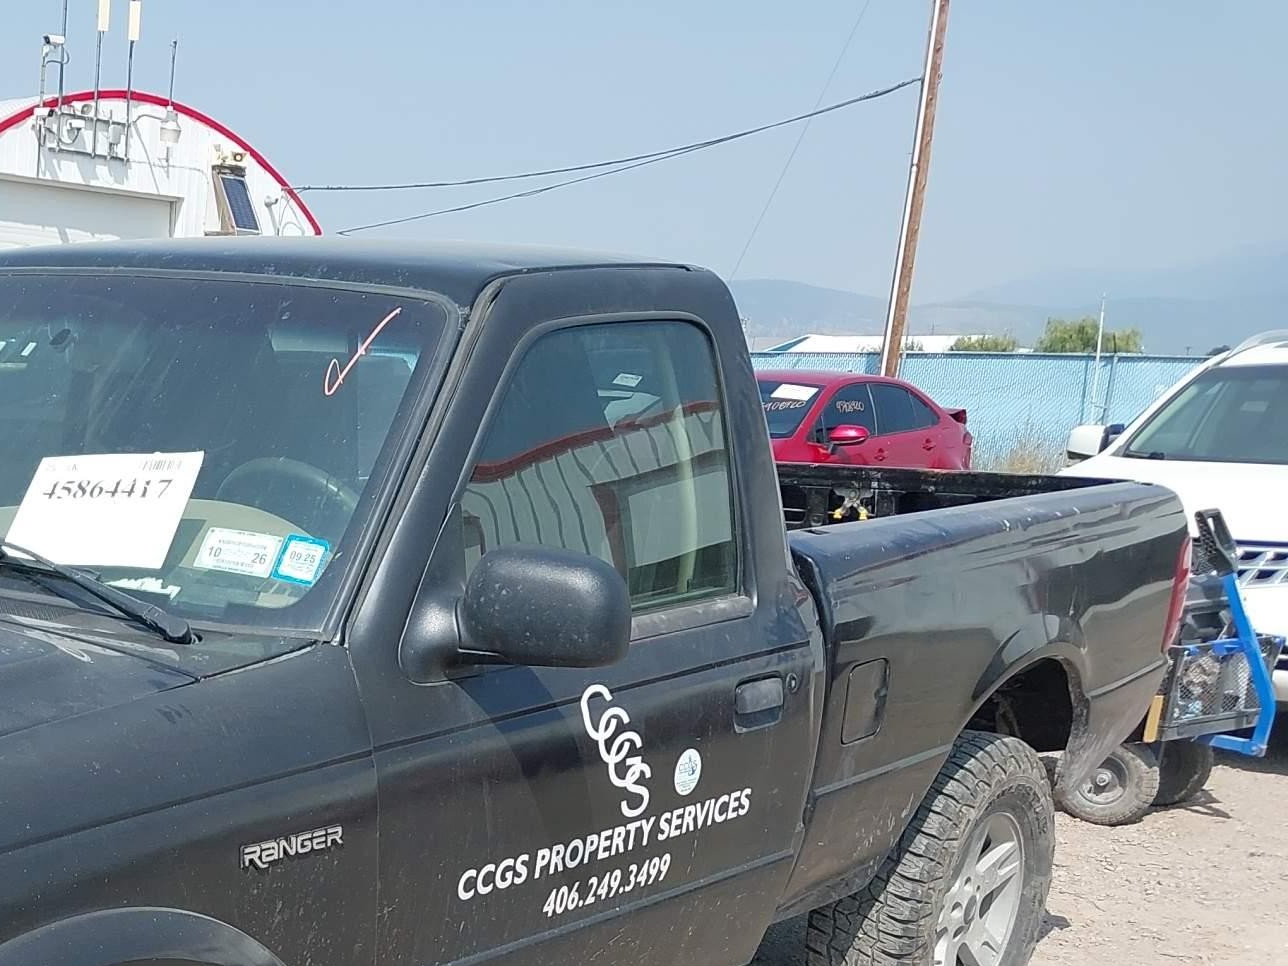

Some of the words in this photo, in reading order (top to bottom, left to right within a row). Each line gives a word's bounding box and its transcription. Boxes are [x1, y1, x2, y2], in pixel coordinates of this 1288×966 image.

[42, 478, 173, 500] 45864417
[208, 546, 222, 558] 10
[251, 552, 267, 566] 26
[241, 824, 344, 869] RANGER
[458, 854, 529, 900] CCGS
[534, 816, 656, 879] PROPERTY
[657, 788, 752, 841] SERVICES
[543, 853, 672, 917] 406.249.3499
